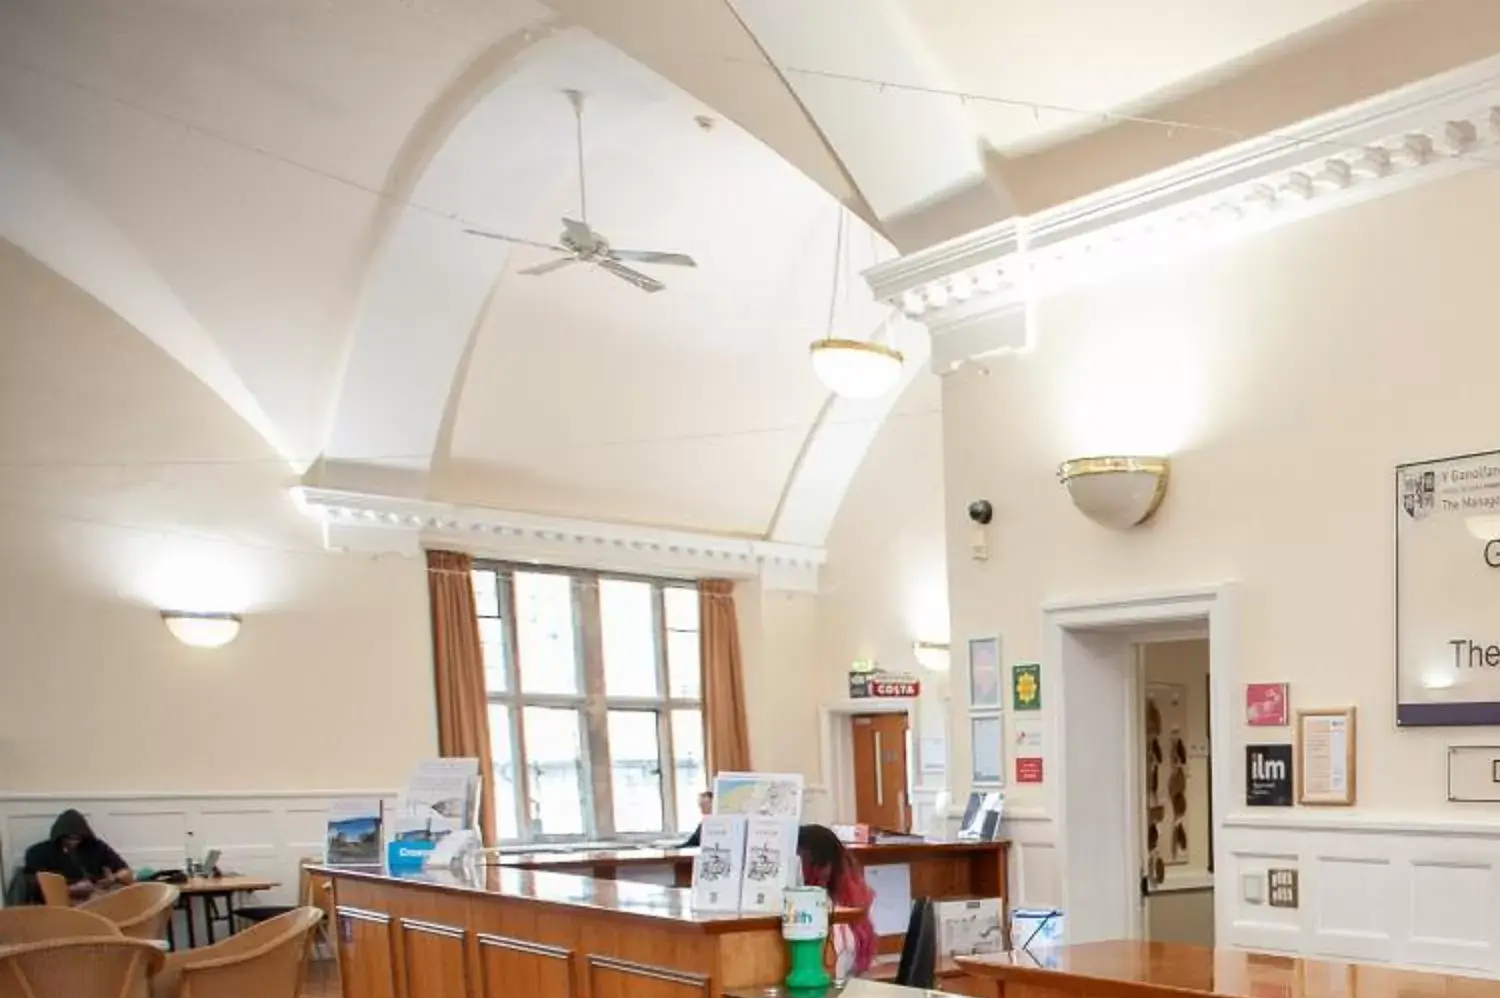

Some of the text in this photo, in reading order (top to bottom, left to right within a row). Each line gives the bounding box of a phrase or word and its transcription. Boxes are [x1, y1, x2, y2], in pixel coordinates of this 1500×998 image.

[1442, 498, 1459, 511] The
[1448, 638, 1500, 668] The
[877, 683, 916, 695] COSTA
[1251, 752, 1286, 780] ilm
